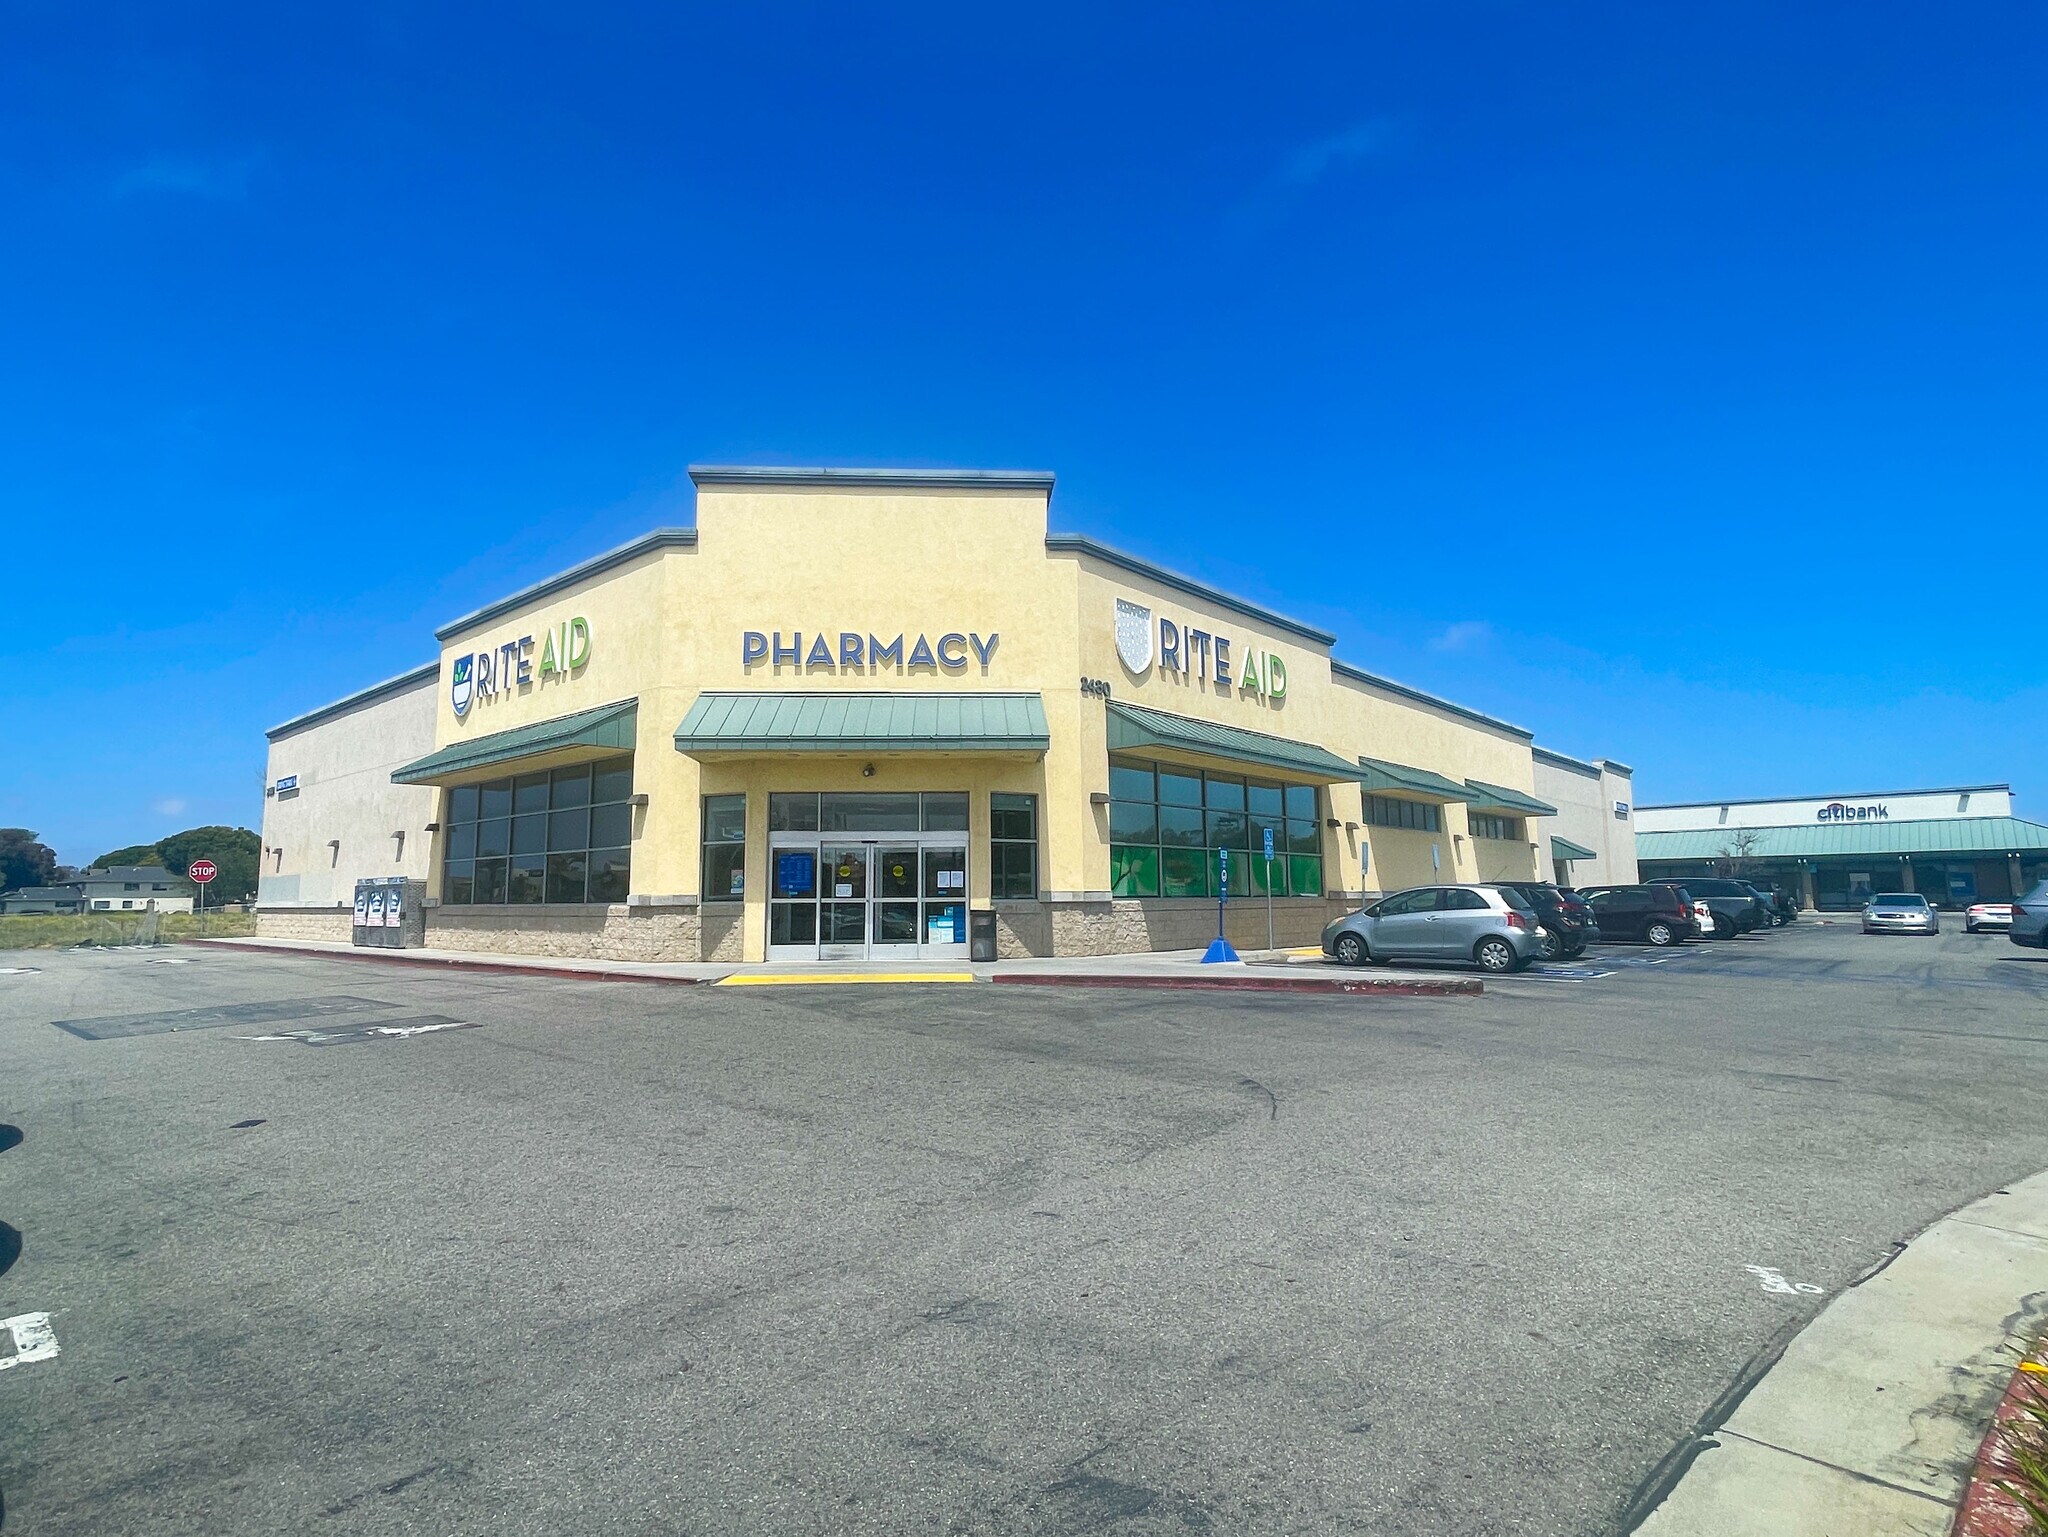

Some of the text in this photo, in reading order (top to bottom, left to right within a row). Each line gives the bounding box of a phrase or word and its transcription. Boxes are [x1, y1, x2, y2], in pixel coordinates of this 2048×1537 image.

[477, 615, 593, 697] RITE AID
[743, 631, 1000, 667] PHARMACY
[1158, 616, 1287, 698] RITE AID
[1817, 803, 1889, 820] citibank
[191, 866, 215, 876] STOP
